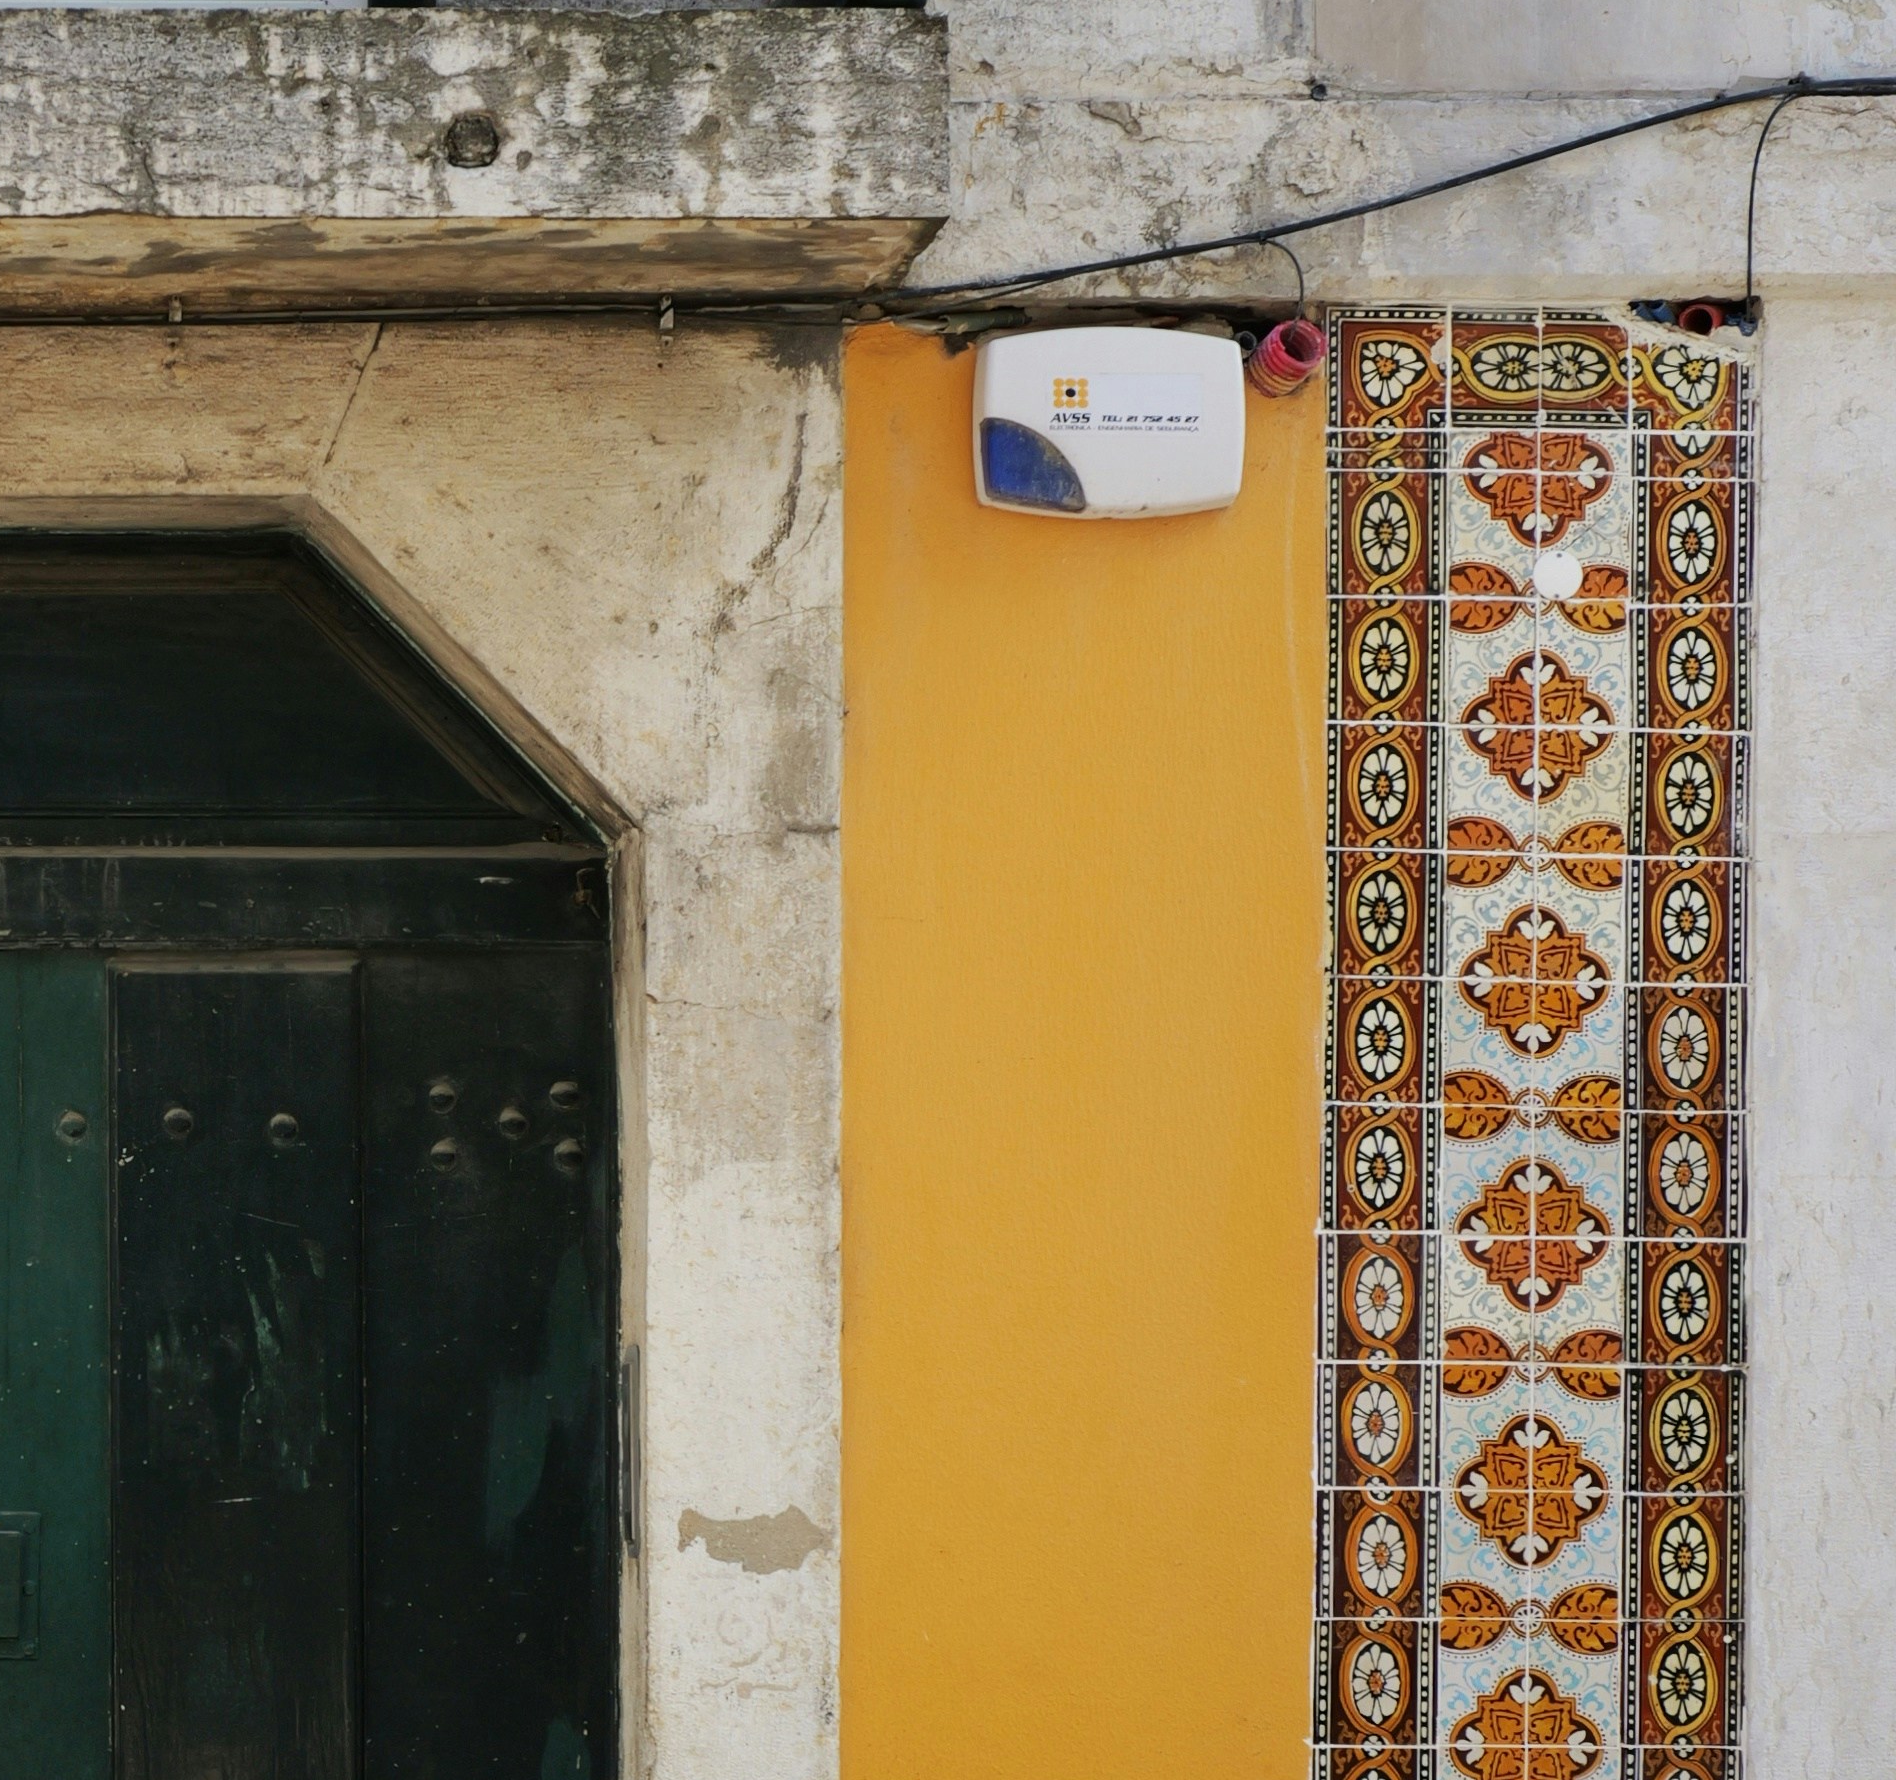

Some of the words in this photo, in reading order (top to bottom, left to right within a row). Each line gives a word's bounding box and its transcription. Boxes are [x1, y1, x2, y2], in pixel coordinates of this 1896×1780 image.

[1050, 412, 1091, 423] AVSS
[1126, 414, 1138, 423] 21
[1166, 414, 1181, 423] 45
[1184, 414, 1200, 423] 27
